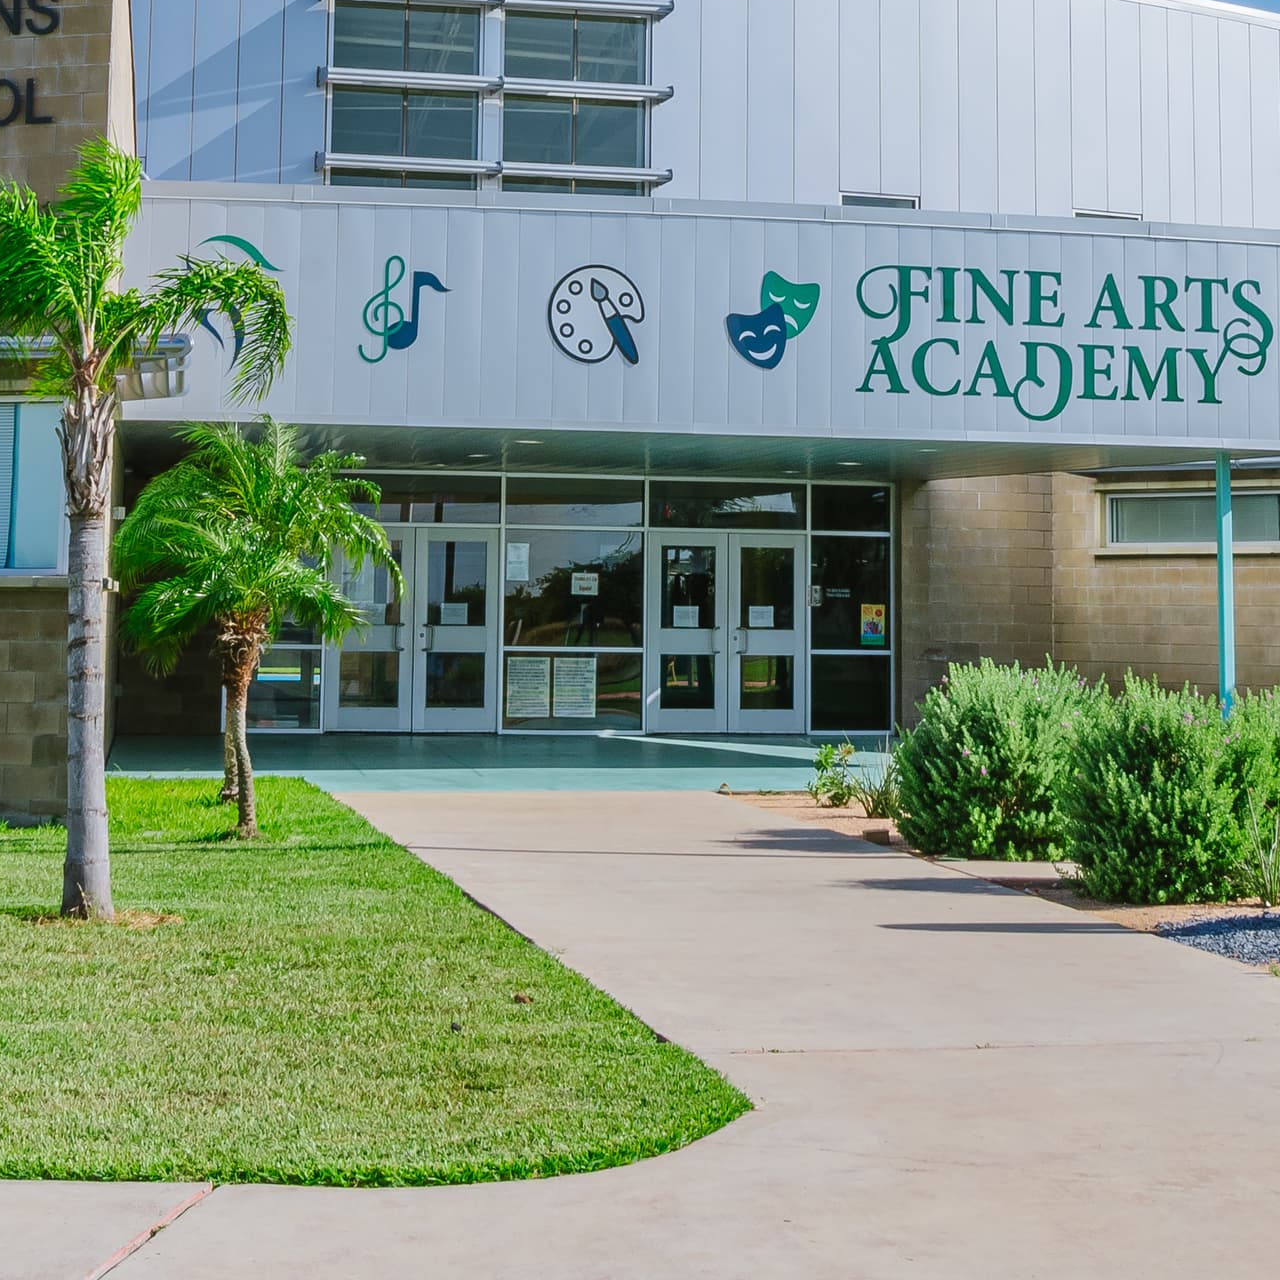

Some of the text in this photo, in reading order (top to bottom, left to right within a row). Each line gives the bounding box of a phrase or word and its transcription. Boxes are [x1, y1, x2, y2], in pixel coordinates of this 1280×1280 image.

[856, 264, 1274, 376] FINE ARTS
[855, 336, 1233, 422] ACADEMY
